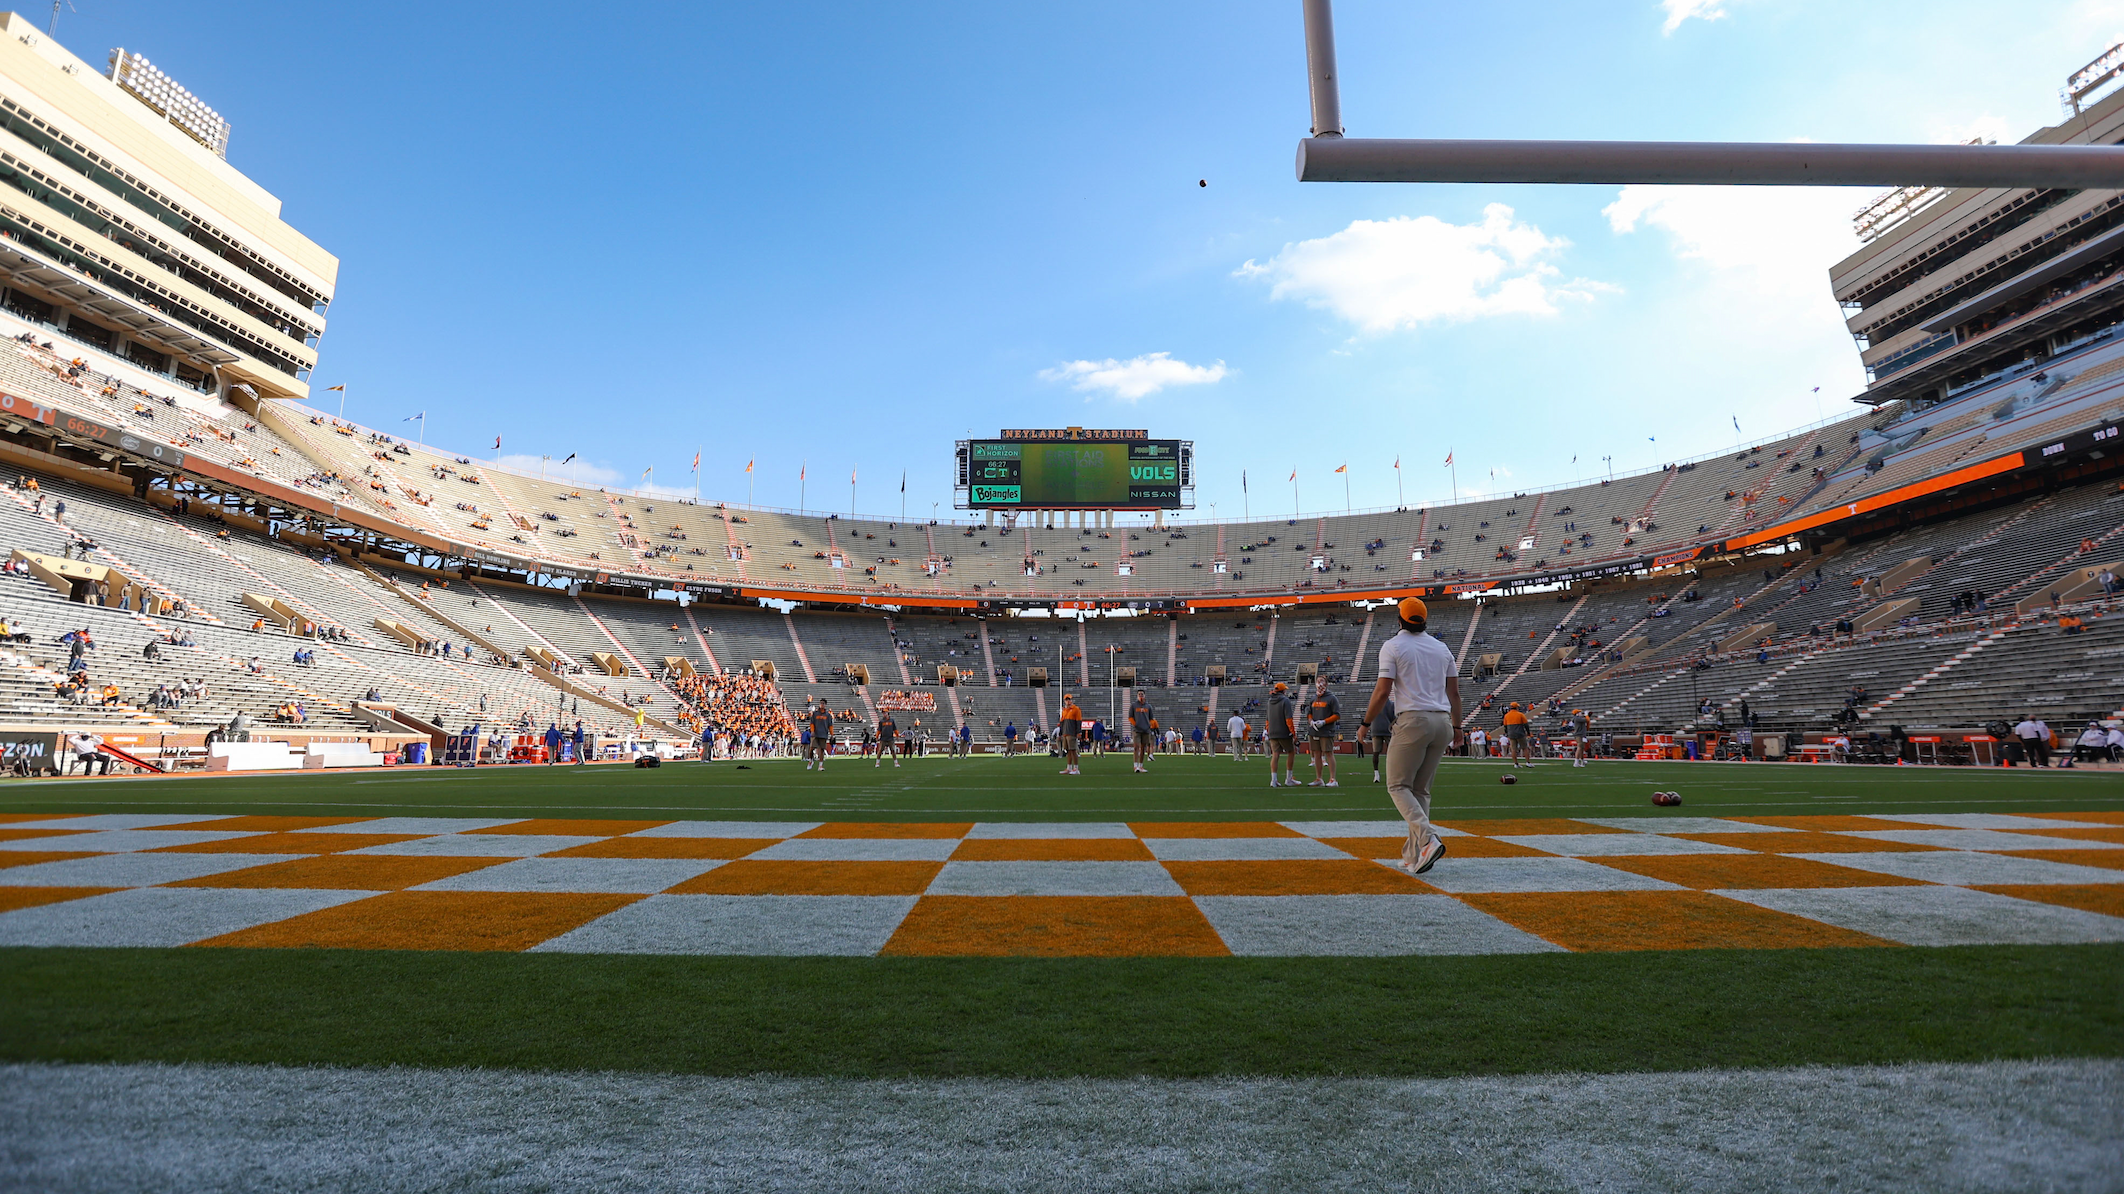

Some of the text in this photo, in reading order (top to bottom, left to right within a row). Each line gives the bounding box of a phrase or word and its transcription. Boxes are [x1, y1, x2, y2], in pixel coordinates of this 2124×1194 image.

[67, 417, 108, 439] 66:27
[1005, 429, 1065, 438] NEYLAND
[1085, 429, 1144, 438] STADIUM
[153, 446, 163, 457] 0
[1045, 450, 1104, 460] FIRST AID
[1130, 466, 1175, 480] VOLS
[975, 487, 1019, 501] Bojangles
[1657, 551, 1694, 565] CHAMPIONS
[610, 576, 630, 585] WILLIS
[630, 579, 653, 587] TUCKER
[704, 586, 723, 594] FUSON
[1451, 583, 1487, 592] NATIONAL
